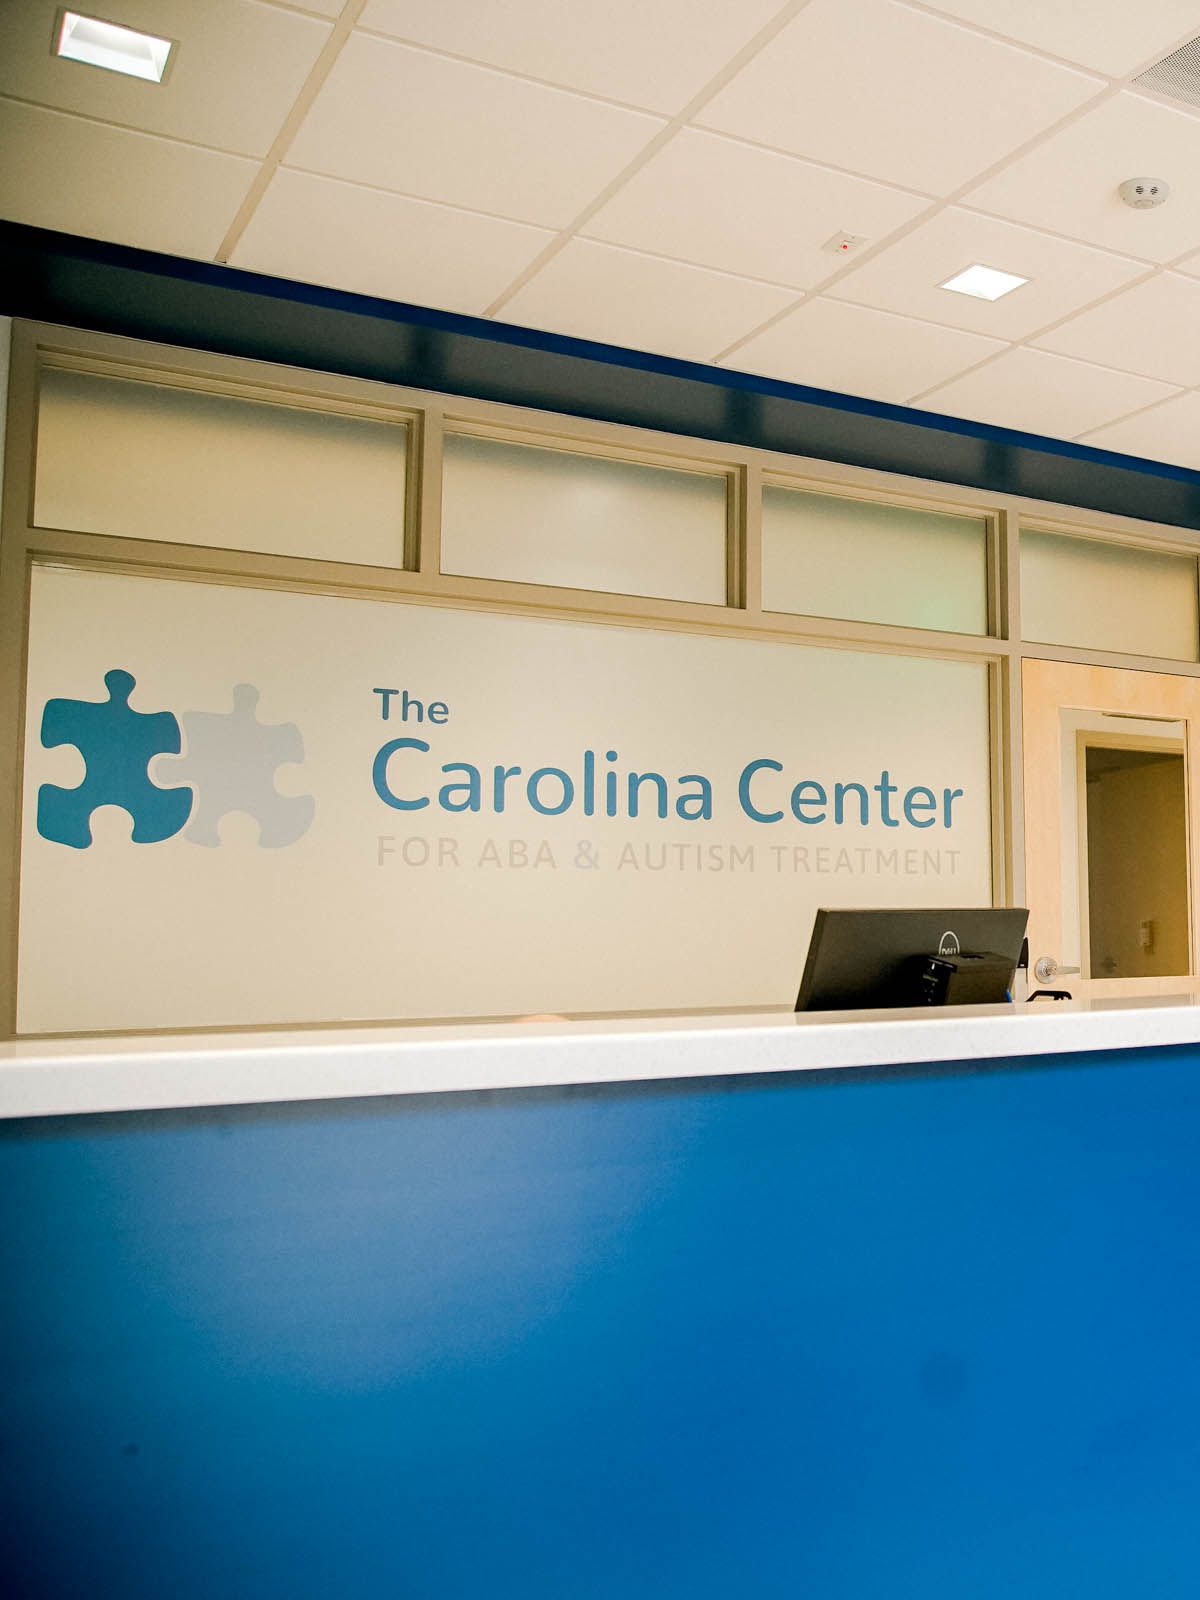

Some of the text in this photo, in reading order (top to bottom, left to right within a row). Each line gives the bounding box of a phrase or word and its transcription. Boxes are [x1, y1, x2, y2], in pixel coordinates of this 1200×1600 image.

[373, 688, 449, 725] The
[372, 737, 964, 829] Carolina Center
[376, 835, 961, 876] FOR ABA & AUTISM TREATMENT
